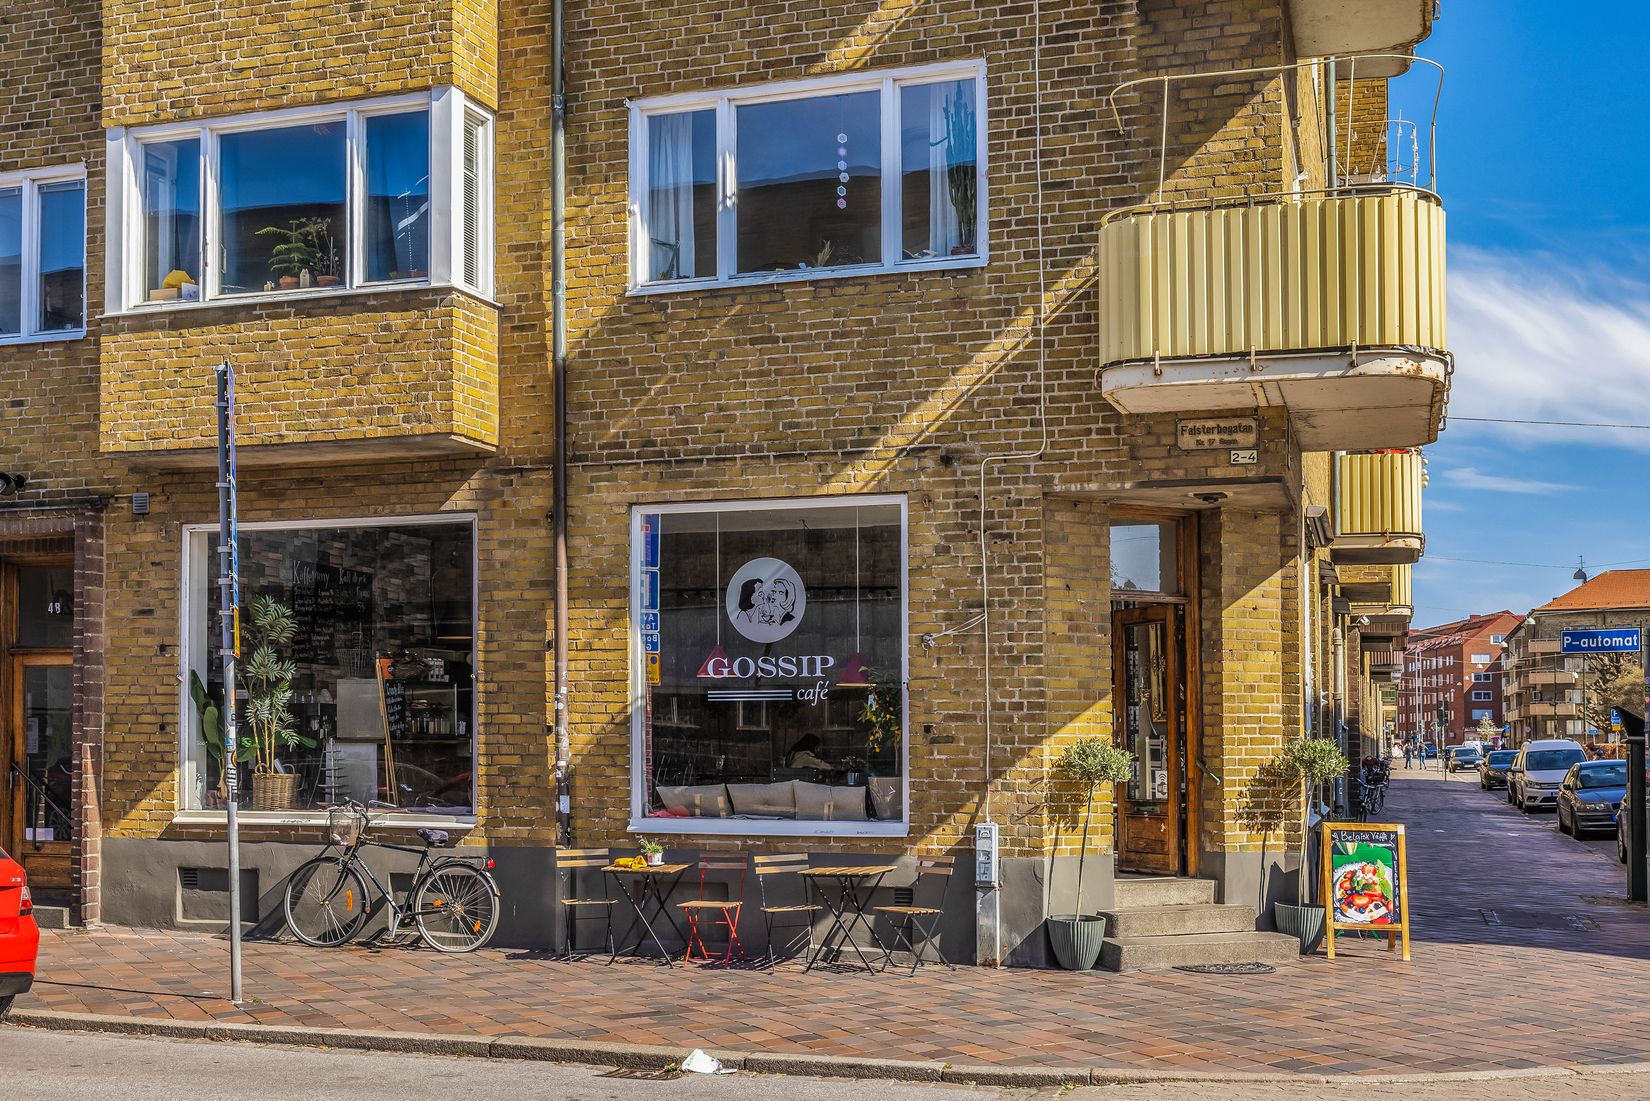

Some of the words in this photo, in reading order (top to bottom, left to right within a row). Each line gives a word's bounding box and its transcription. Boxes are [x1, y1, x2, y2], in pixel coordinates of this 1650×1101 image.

[1232, 452, 1256, 463] 2-4
[1563, 634, 1638, 648] P-automat
[707, 655, 835, 679] GOSSIP
[796, 680, 829, 706] café
